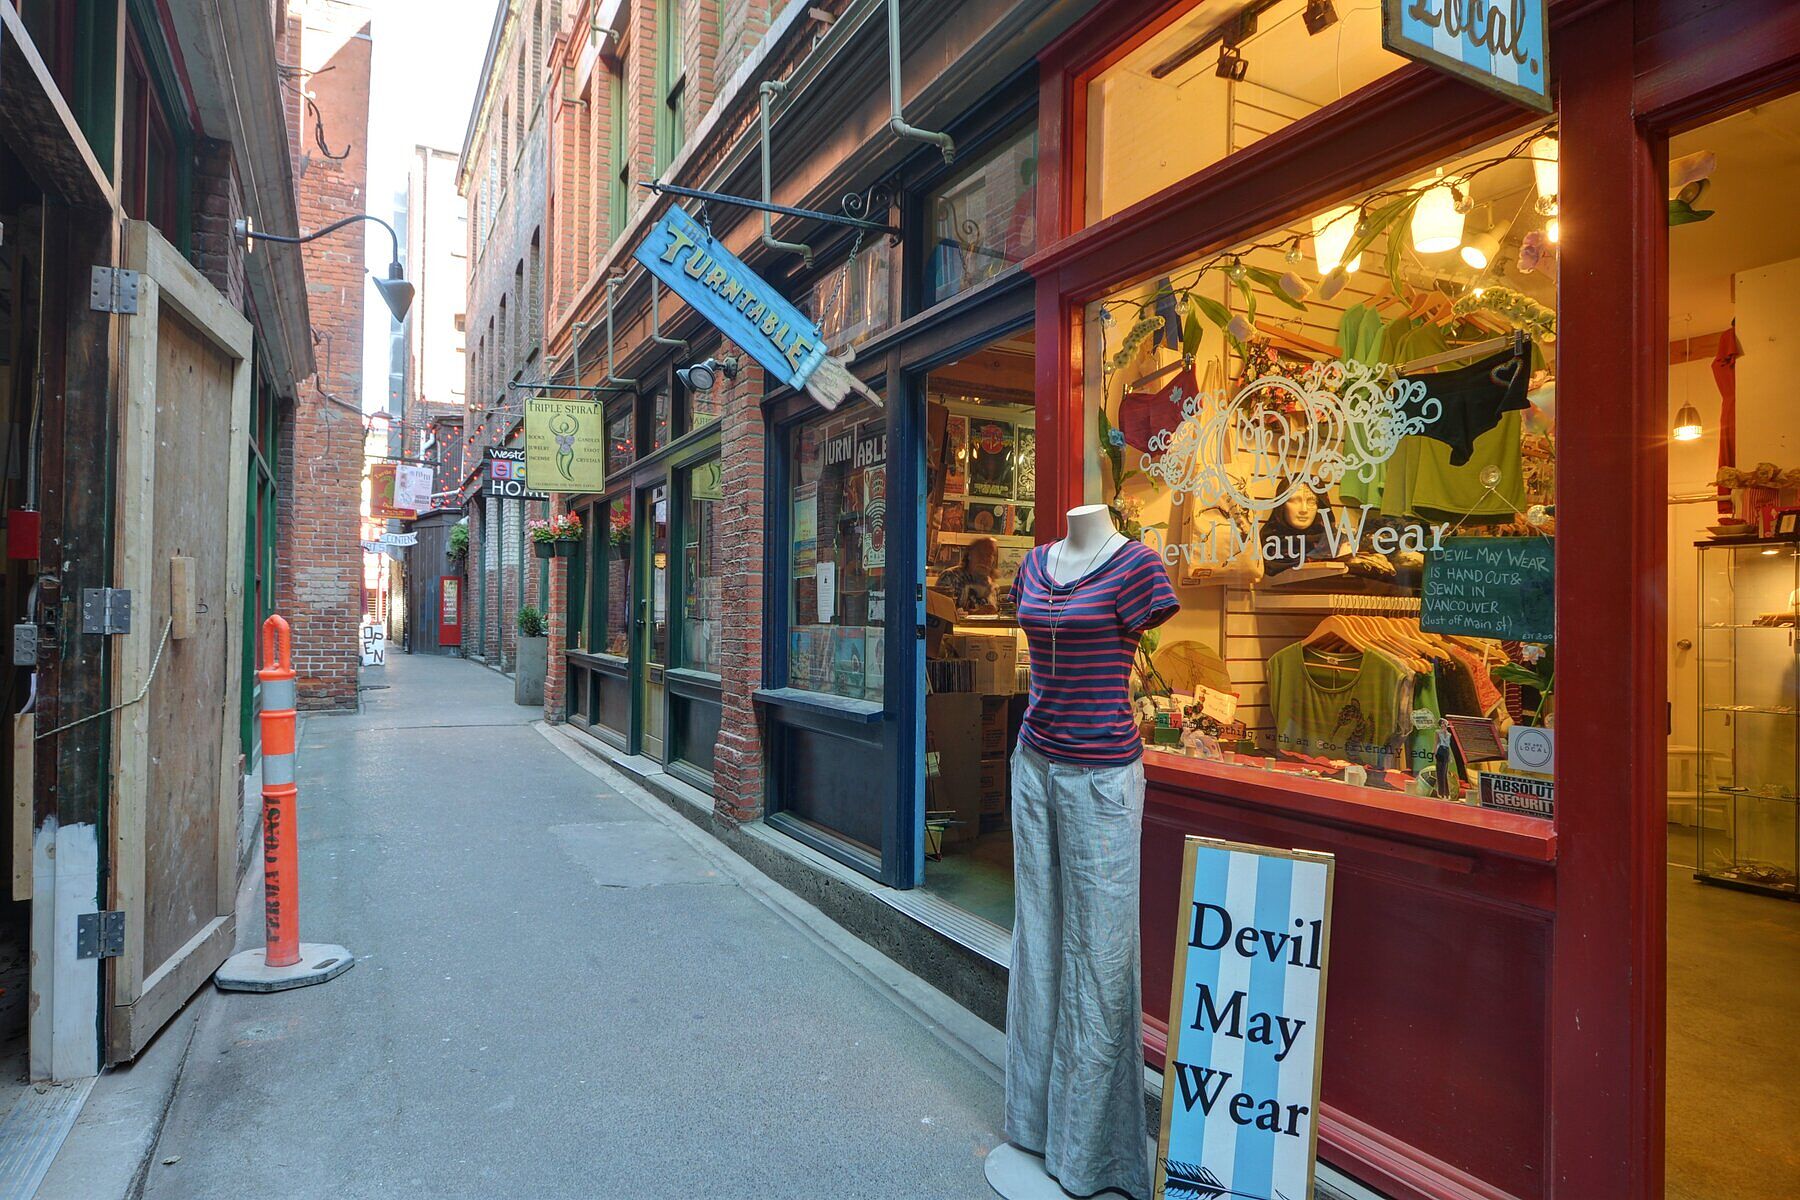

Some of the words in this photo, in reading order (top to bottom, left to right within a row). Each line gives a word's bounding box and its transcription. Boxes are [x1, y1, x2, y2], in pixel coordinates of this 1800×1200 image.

[682, 220, 705, 244] THE
[659, 221, 815, 373] TURNTABLE
[528, 402, 562, 413] TRIPLE
[565, 404, 600, 415] SPIRAL
[387, 534, 416, 545] CONTENT
[1229, 514, 1305, 570] May
[1317, 504, 1450, 558] Wear
[1433, 549, 1472, 561] DEVIL
[1476, 547, 1503, 566] MAY
[1507, 548, 1550, 572] WEAR
[1430, 567, 1441, 579] IS
[1425, 581, 1464, 596] SEWN
[1472, 586, 1485, 597] IN
[1425, 598, 1500, 614] VANCOUVER
[1448, 614, 1463, 625] off
[1520, 745, 1548, 754] LOCAL
[1188, 901, 1322, 970] Devil
[1190, 982, 1306, 1063] May
[1172, 1061, 1310, 1138] Wear
